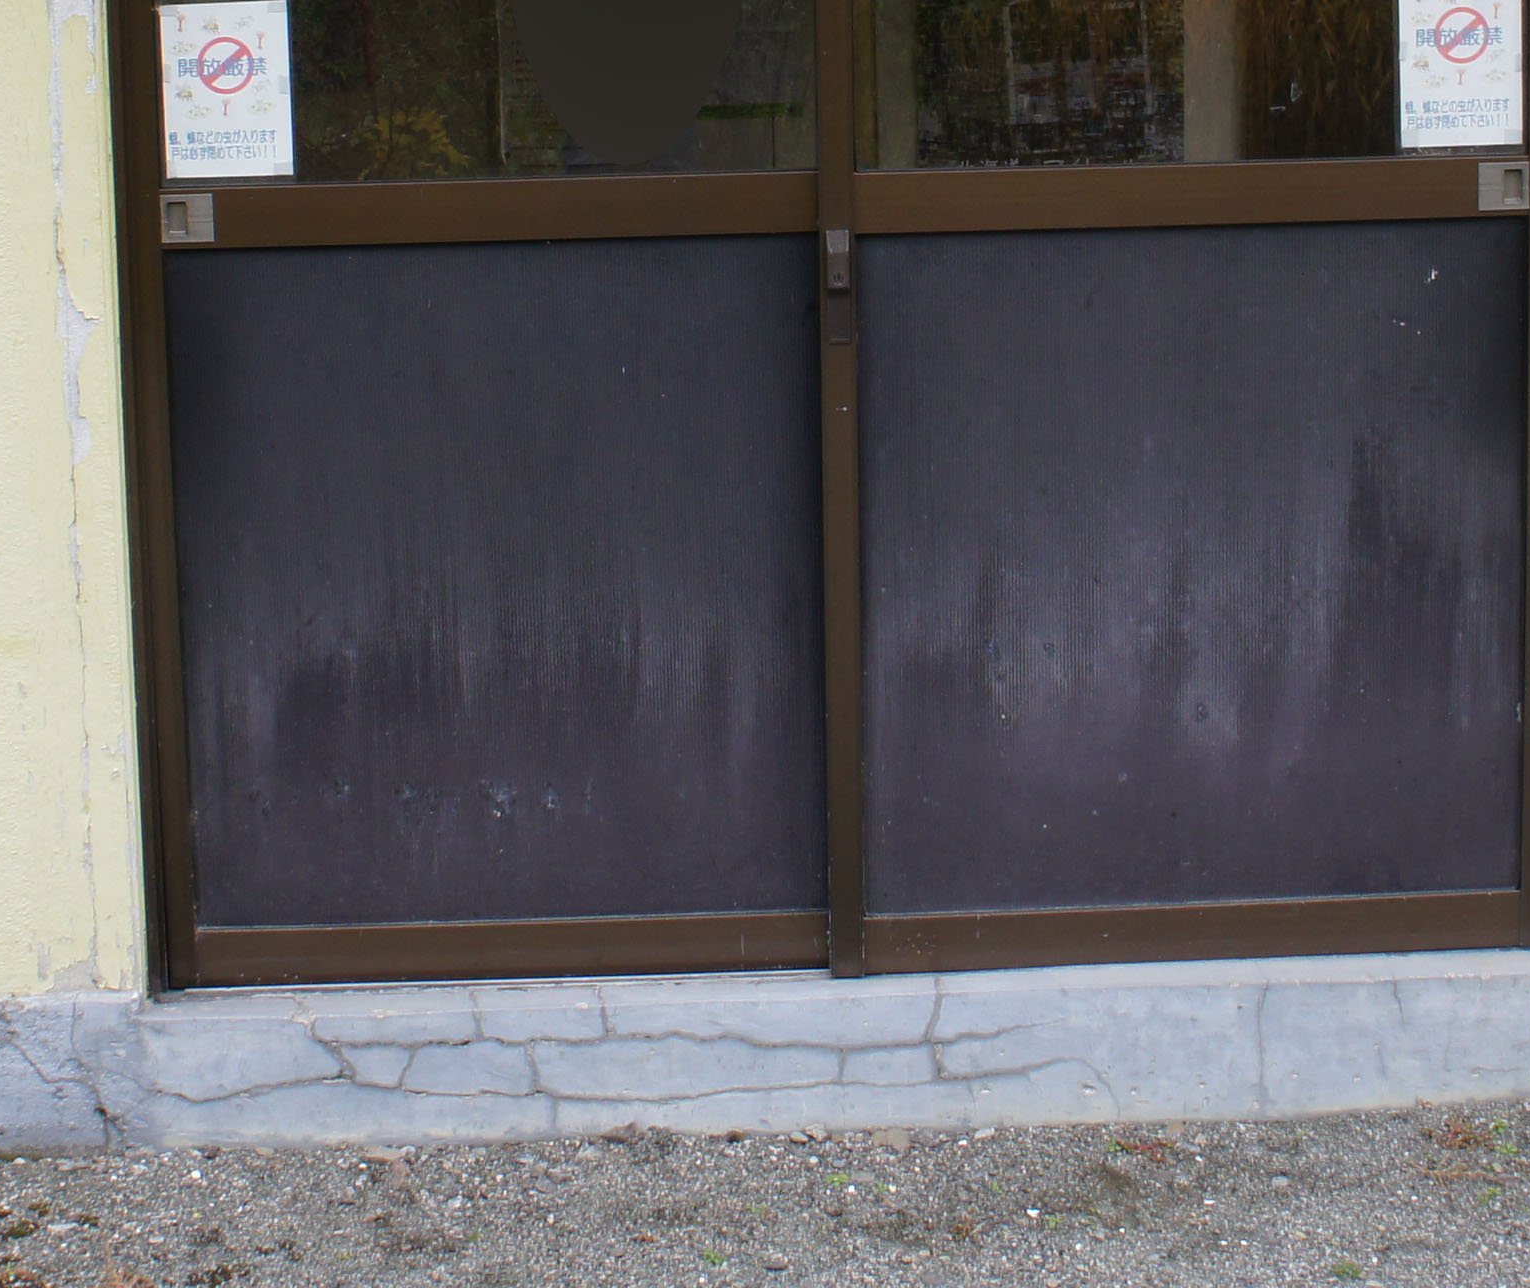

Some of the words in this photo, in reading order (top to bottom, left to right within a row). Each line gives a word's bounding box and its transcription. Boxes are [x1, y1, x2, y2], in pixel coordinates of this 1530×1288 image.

[1415, 27, 1503, 48] 開放厳禁
[177, 56, 268, 78] 開放厳禁
